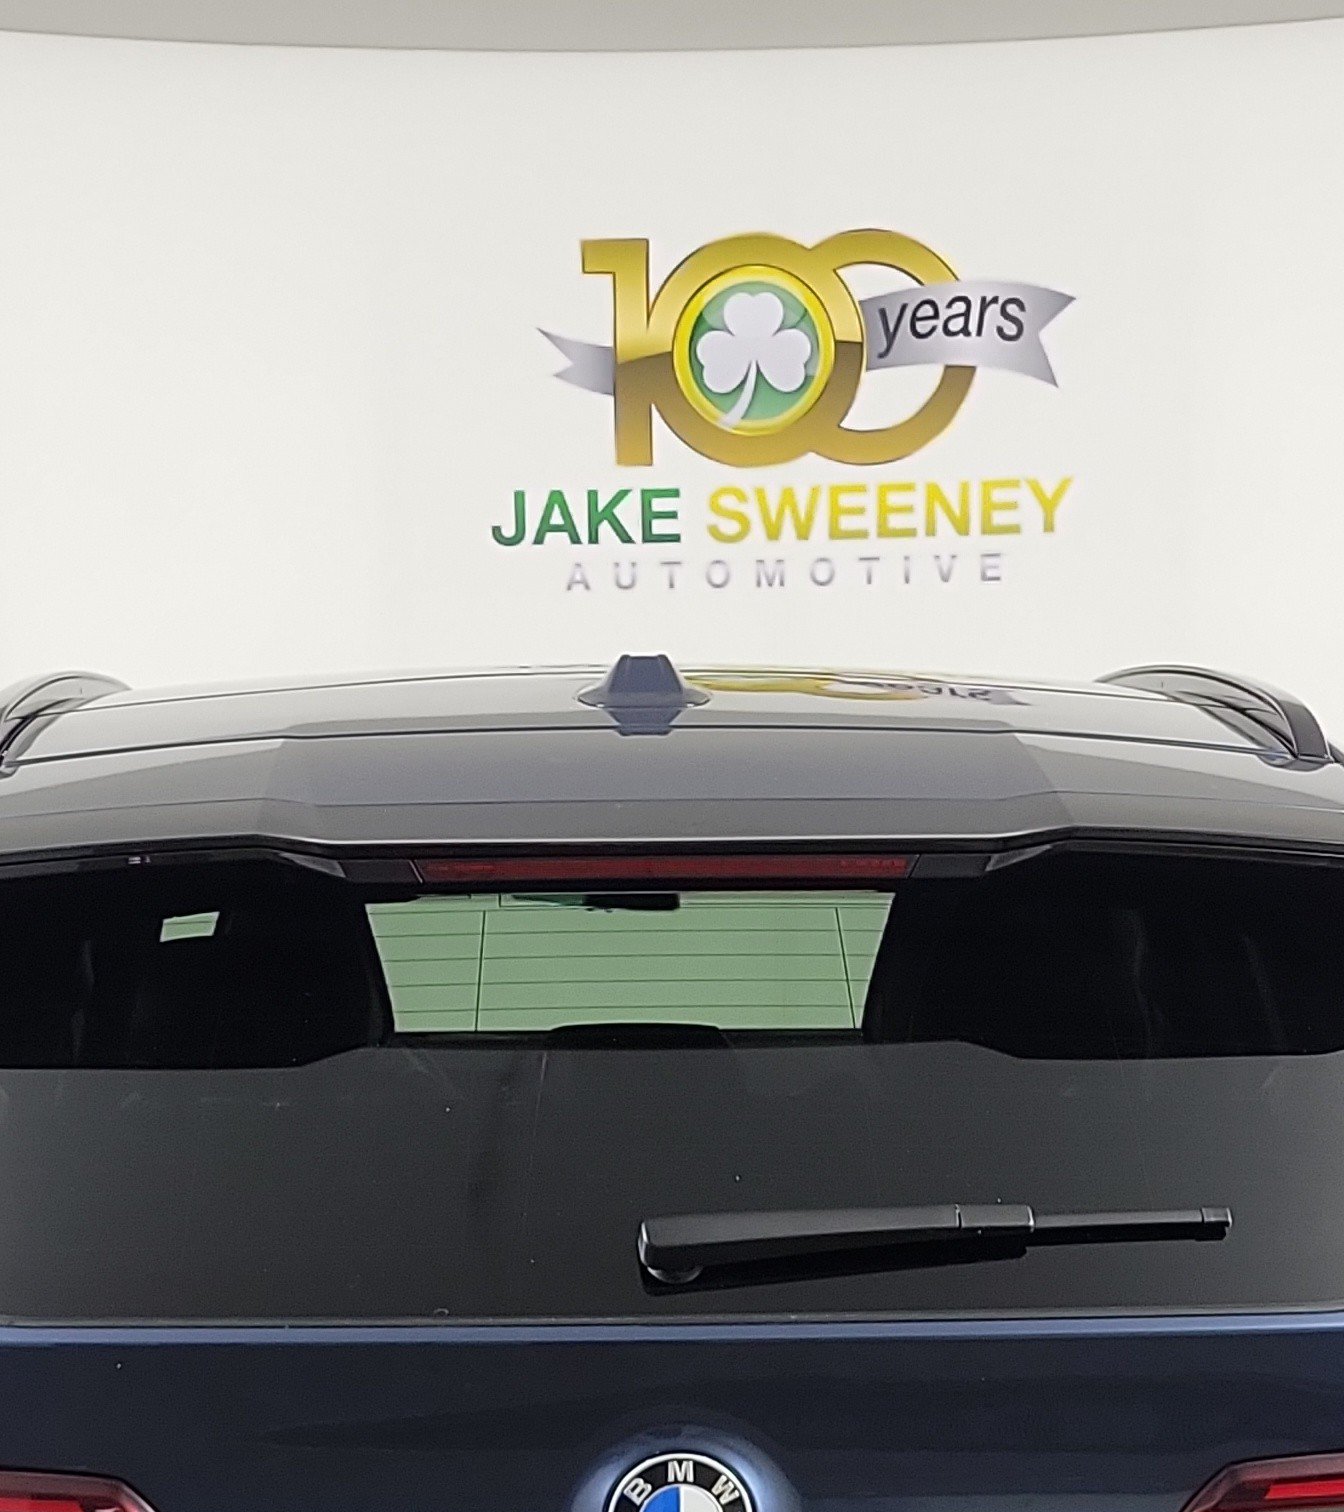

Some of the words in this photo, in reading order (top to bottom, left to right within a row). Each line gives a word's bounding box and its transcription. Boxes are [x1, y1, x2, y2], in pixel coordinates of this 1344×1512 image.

[580, 228, 977, 468] 100
[876, 294, 1028, 359] years
[491, 488, 682, 547] JAKE
[706, 477, 1074, 544] SWEENEY
[566, 553, 1003, 594] AUTOMOTIVE
[623, 1460, 740, 1506] BMW
